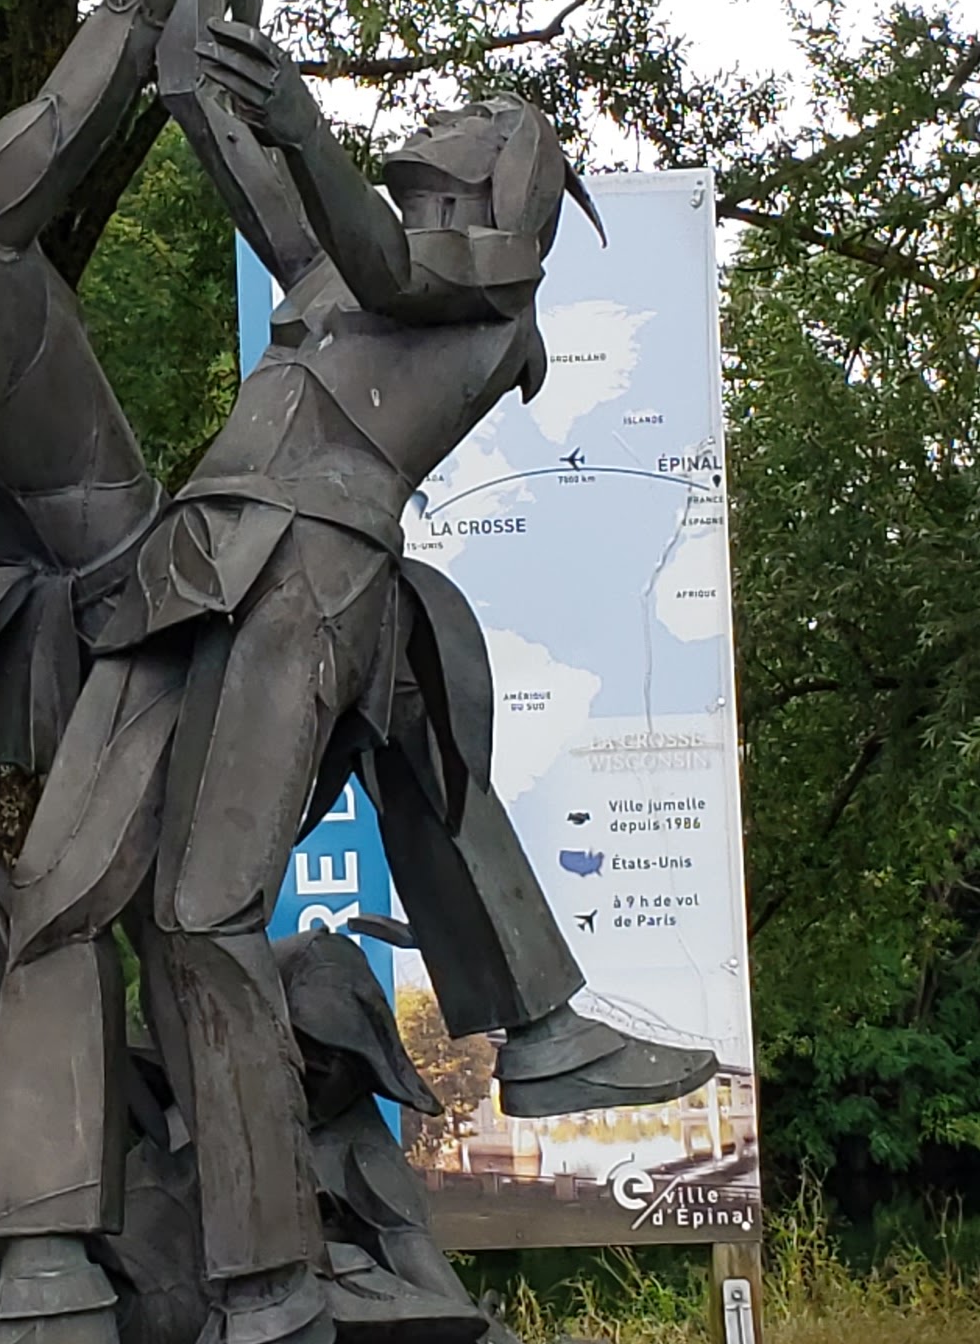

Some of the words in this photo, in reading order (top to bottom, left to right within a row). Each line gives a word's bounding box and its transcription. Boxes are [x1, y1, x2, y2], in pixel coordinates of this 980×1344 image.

[623, 415, 664, 425] ISLANDE
[658, 453, 723, 472] ÉPINAL
[581, 474, 596, 483] km
[687, 496, 723, 504] FRANCE
[431, 521, 452, 536] LA
[457, 518, 527, 535] CROSSE
[676, 589, 716, 598] AFRIQUE
[526, 702, 545, 711] SUD
[609, 800, 643, 812] Ville
[648, 797, 705, 814] jumelle
[610, 819, 660, 834] depuis
[666, 817, 701, 830] 1986
[612, 854, 692, 870] États-Unis
[613, 895, 621, 908] à
[626, 895, 635, 908] 9
[640, 895, 649, 907] h
[654, 894, 671, 907] de
[676, 893, 699, 906] vol
[614, 915, 632, 927] de
[637, 913, 676, 927] Paris
[664, 1187, 719, 1204] ville
